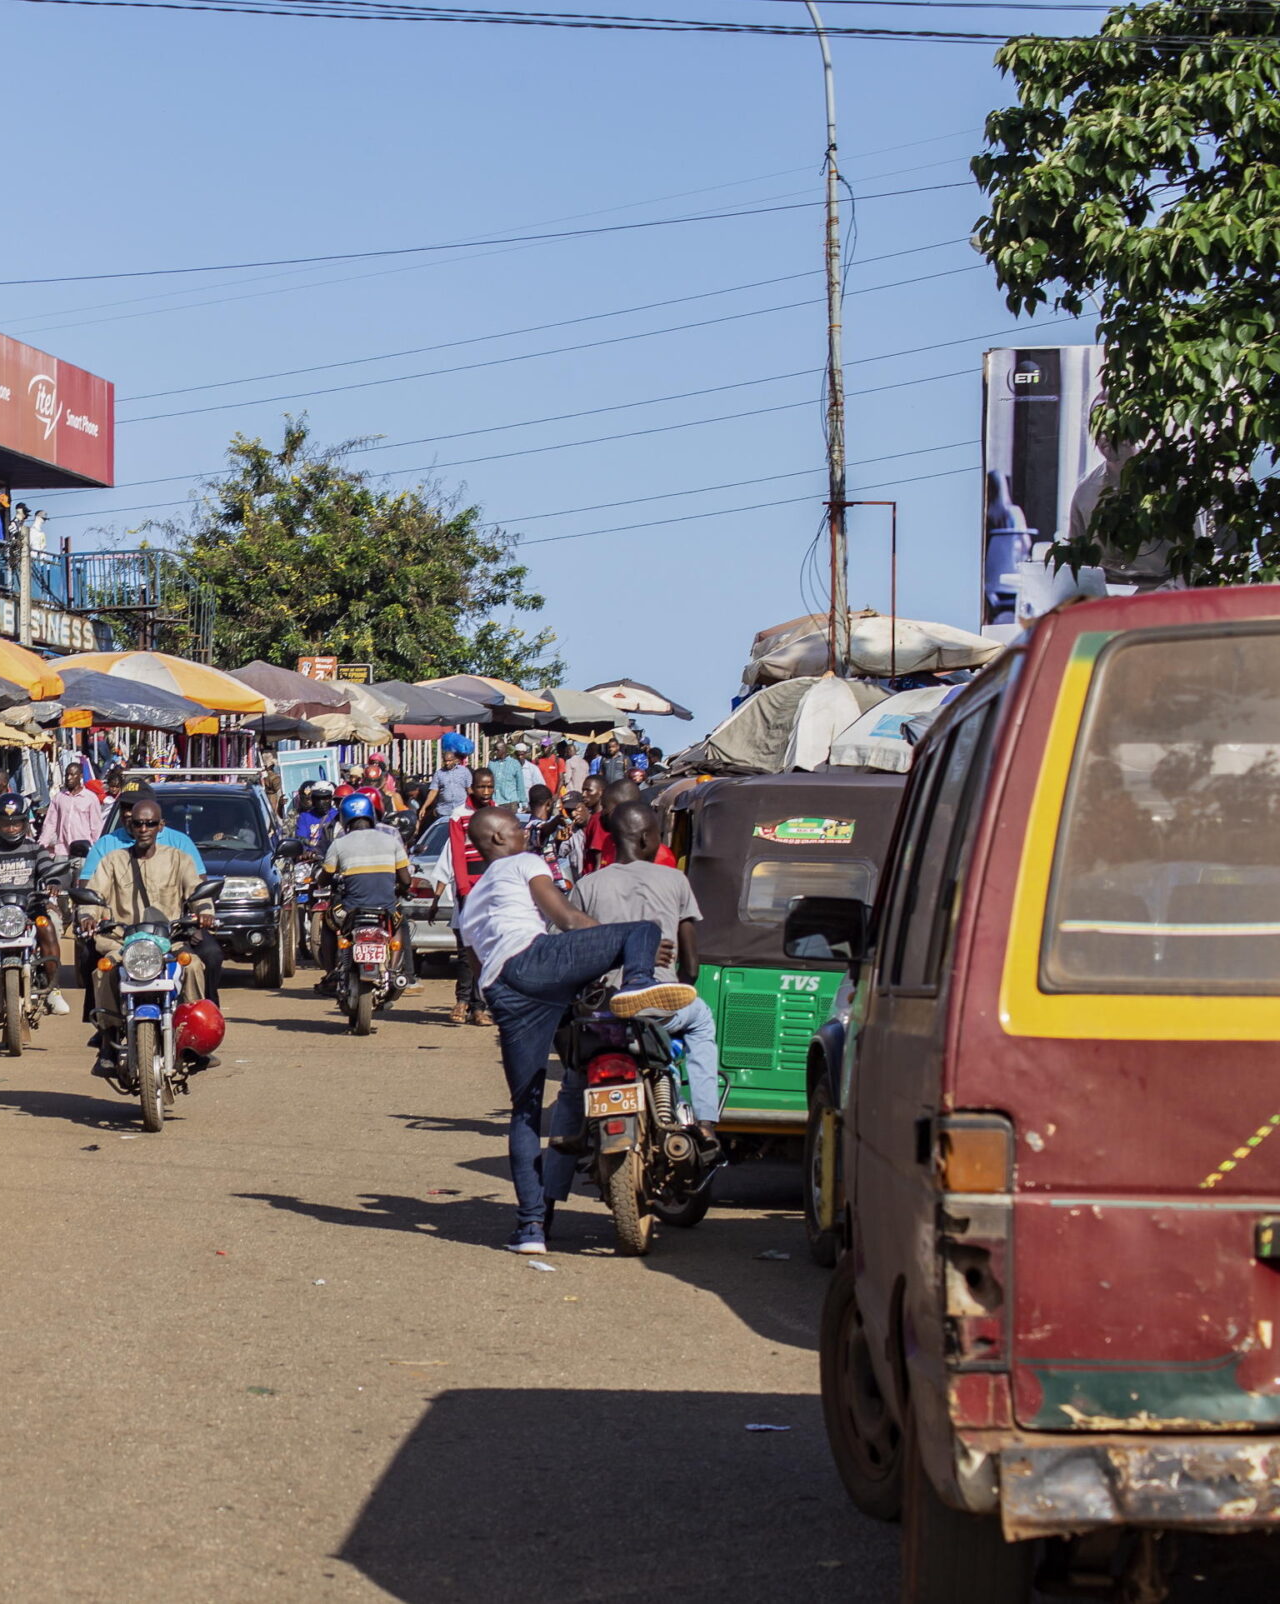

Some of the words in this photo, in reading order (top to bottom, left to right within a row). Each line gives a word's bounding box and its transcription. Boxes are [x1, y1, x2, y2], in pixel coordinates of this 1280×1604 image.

[35, 382, 57, 416] itel
[65, 408, 84, 431] Smart
[82, 415, 100, 439] Phone
[3, 600, 95, 650] BSINESS
[780, 974, 821, 992] TVS
